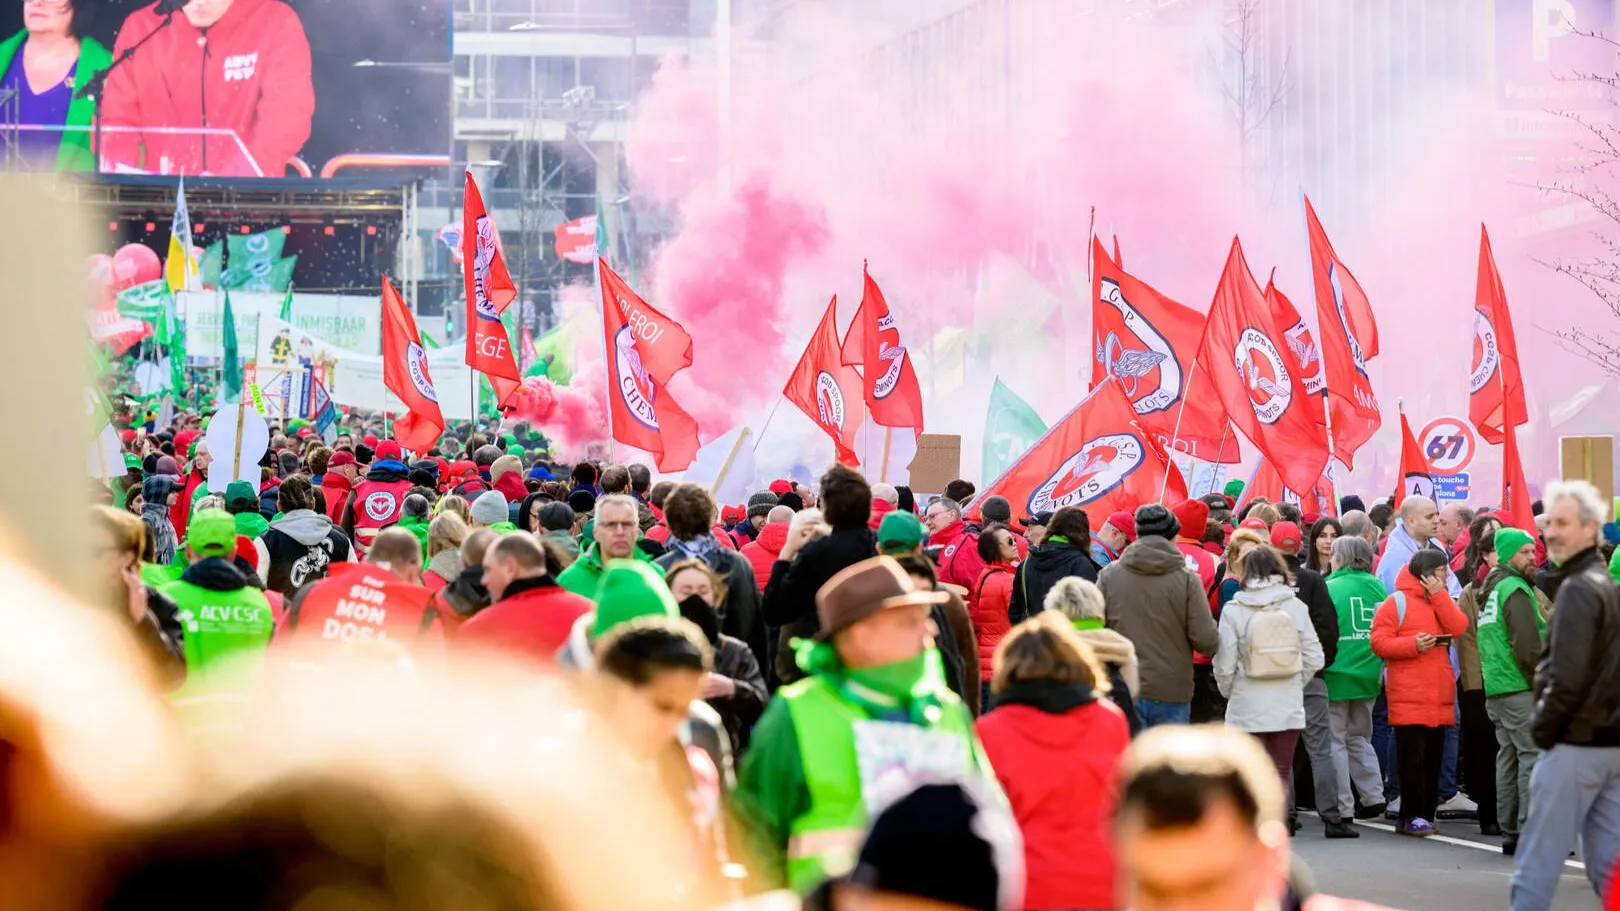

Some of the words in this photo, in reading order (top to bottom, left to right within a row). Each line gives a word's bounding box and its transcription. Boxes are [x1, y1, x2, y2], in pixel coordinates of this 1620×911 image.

[1427, 436, 1464, 459] 67
[350, 585, 386, 606] SUR
[336, 598, 386, 625] MON
